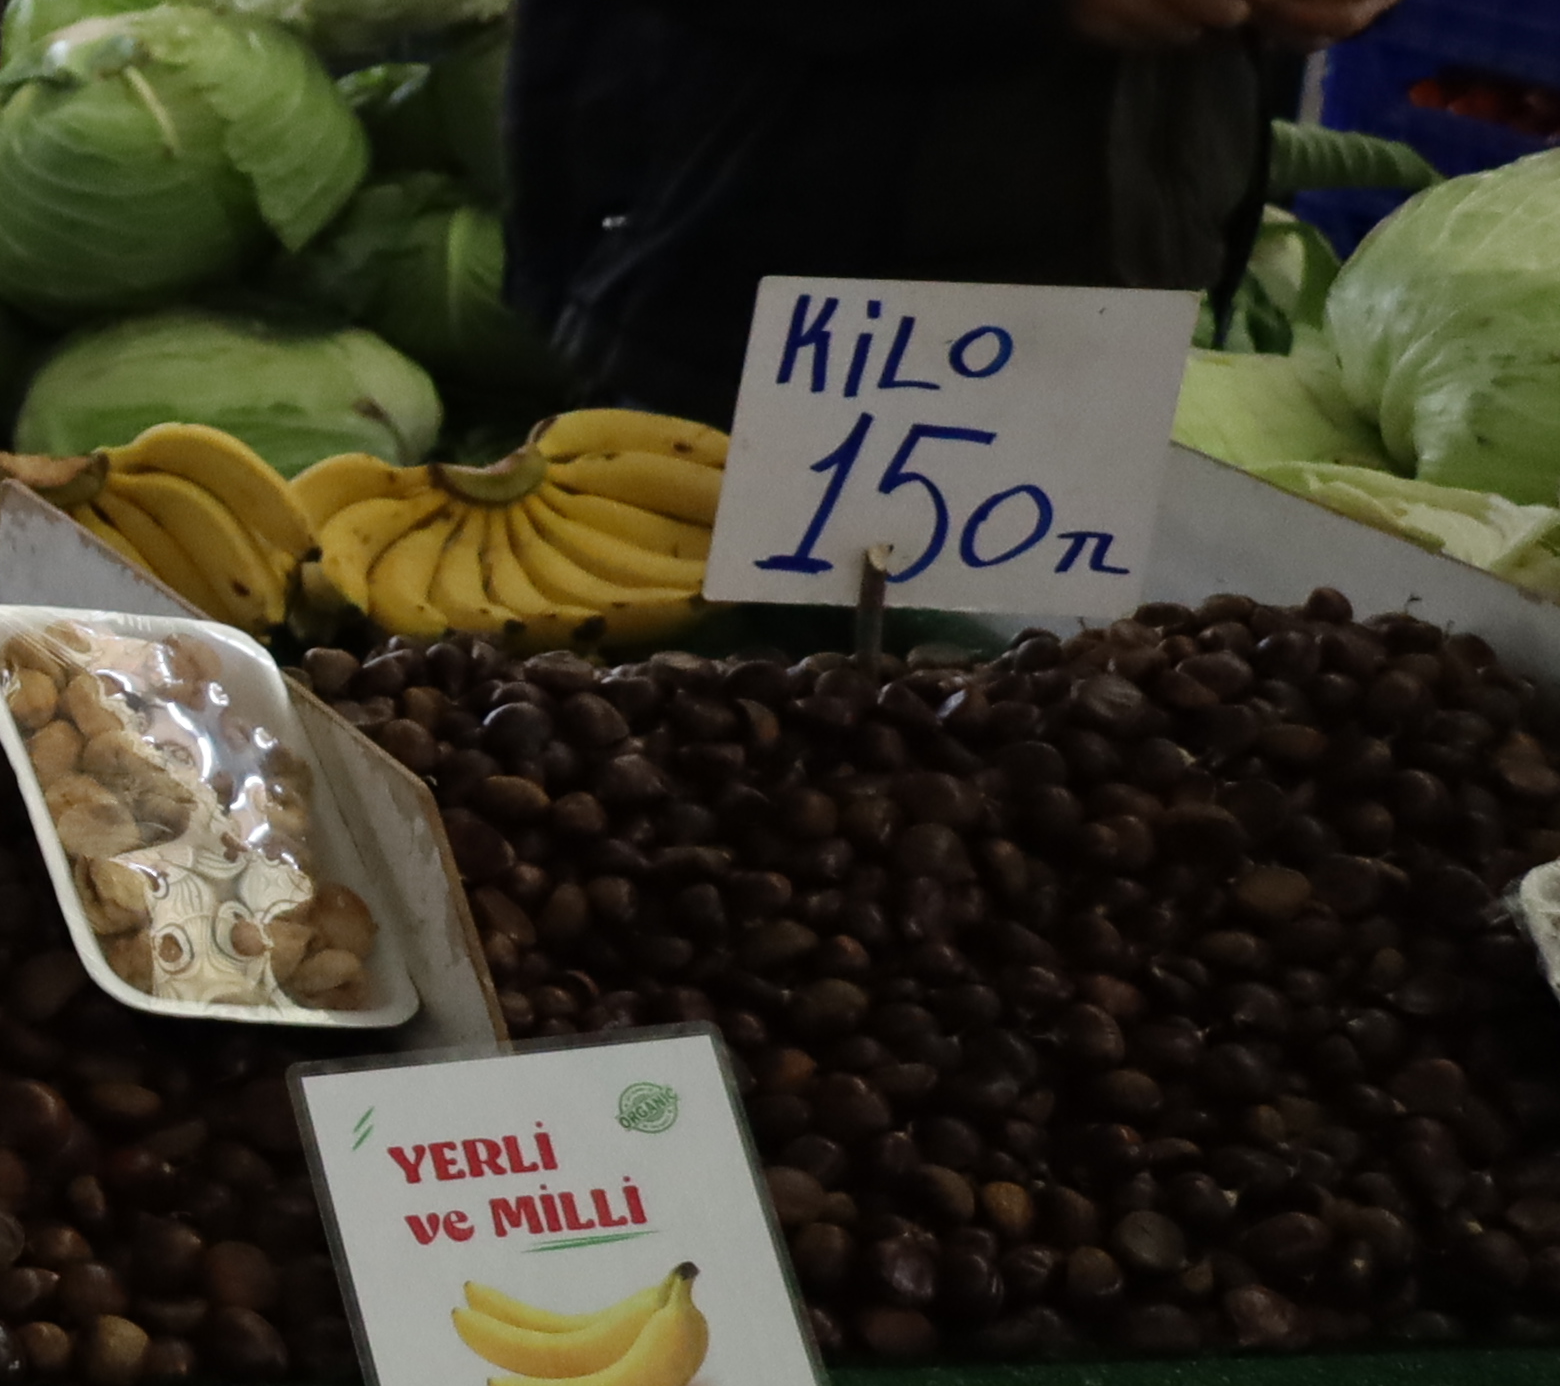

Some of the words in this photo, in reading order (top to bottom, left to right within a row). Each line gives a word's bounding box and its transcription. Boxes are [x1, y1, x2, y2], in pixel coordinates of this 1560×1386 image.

[754, 412, 1053, 583] 150
[615, 1085, 679, 1131] ORGANIC
[387, 1121, 558, 1185] YERLİ
[404, 1209, 474, 1246] ve
[489, 1176, 648, 1238] MİLLİ
